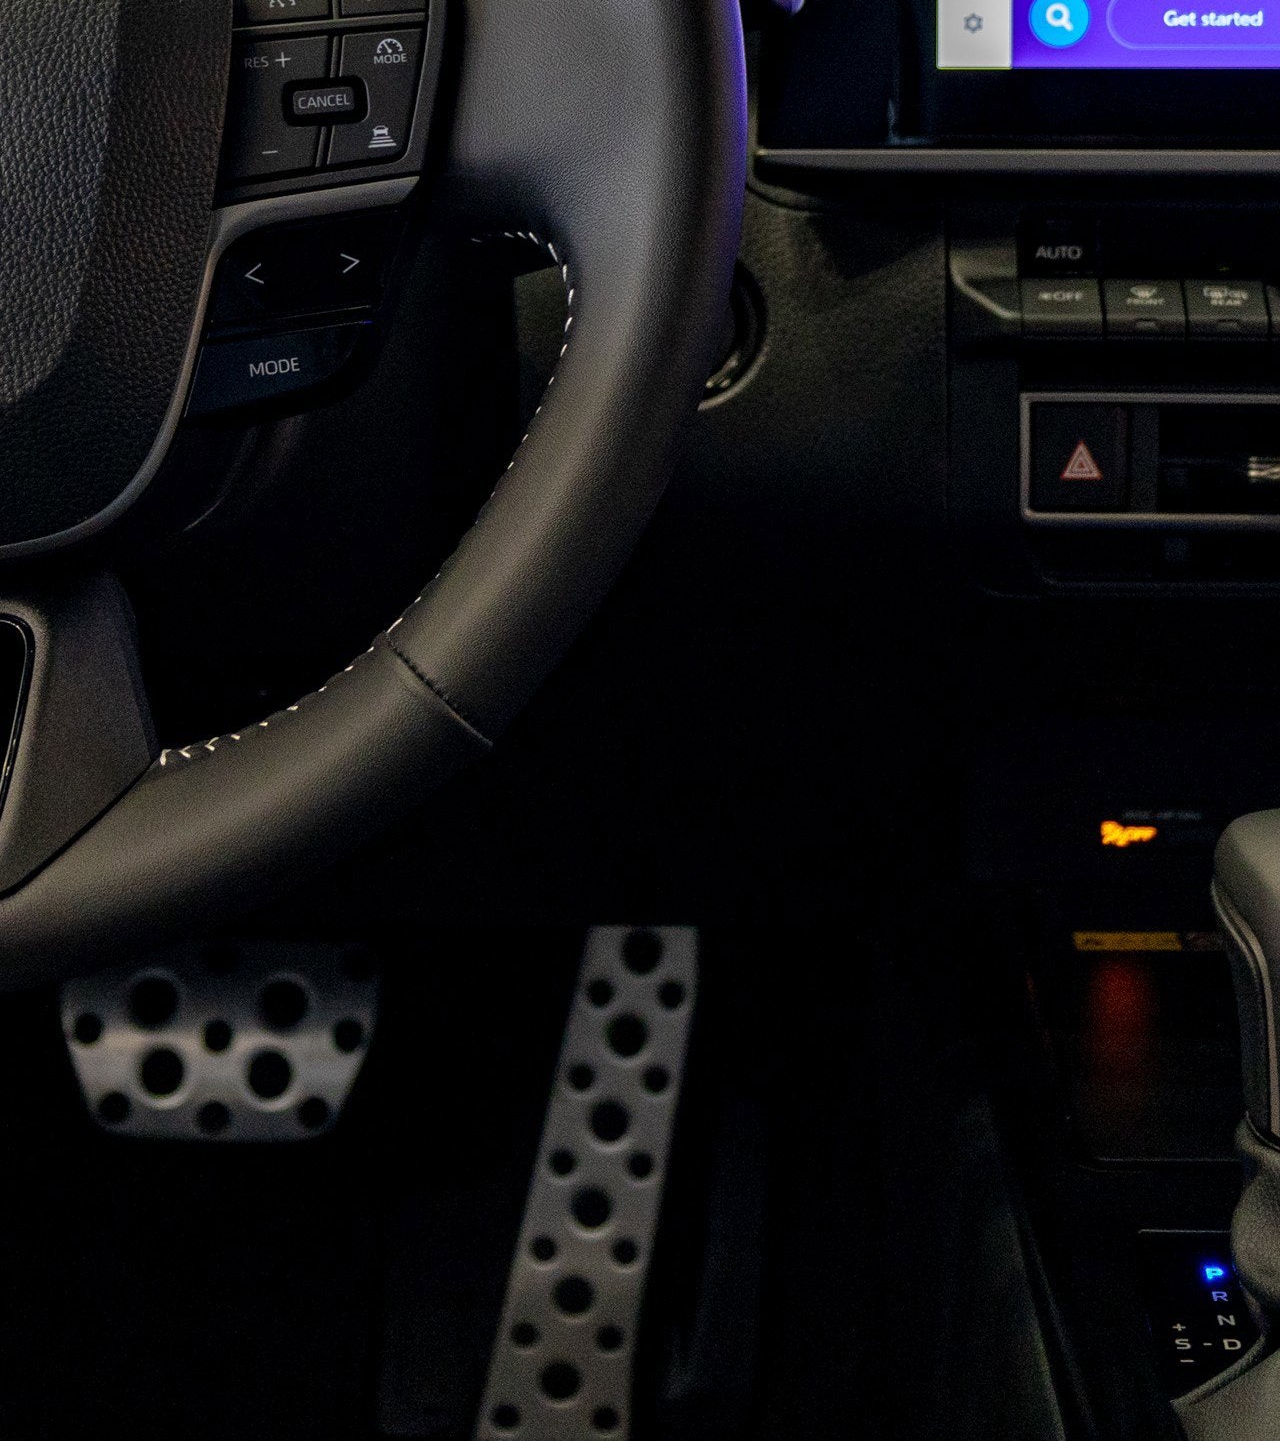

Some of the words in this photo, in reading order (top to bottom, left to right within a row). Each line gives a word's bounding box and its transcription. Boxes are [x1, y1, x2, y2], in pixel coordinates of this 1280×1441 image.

[1163, 9, 1197, 27] Get
[1200, 9, 1264, 27] started
[244, 56, 270, 69] RES
[373, 53, 408, 65] MODE
[298, 93, 350, 110] CANCEL
[1035, 245, 1084, 261] AUTO
[249, 357, 301, 377] MODE
[1205, 1267, 1224, 1280] P
[1211, 1291, 1228, 1302] R
[1217, 1315, 1236, 1326] N
[1175, 1338, 1192, 1350] S
[1224, 1339, 1242, 1350] D
